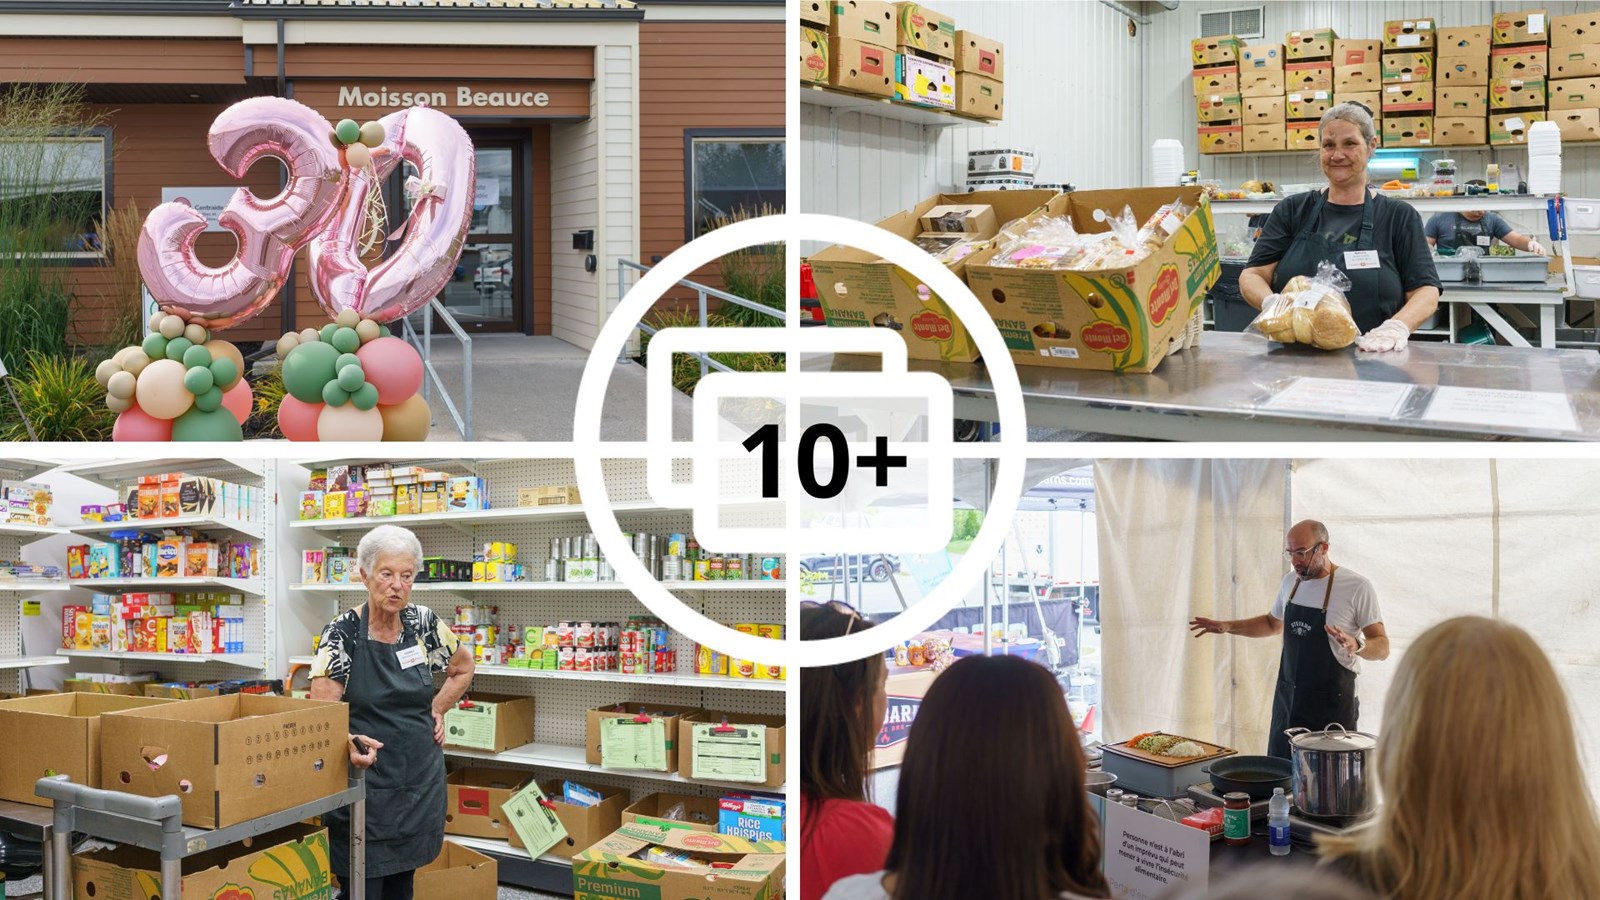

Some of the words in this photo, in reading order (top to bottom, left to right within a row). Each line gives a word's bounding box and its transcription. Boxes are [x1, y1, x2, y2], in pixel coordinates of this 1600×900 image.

[338, 86, 447, 107] Moisson
[457, 86, 549, 107] Beauce
[1122, 830, 1148, 846] Personne
[1149, 841, 1163, 852] n'est
[1169, 847, 1185, 859] l'abri
[1122, 840, 1134, 850] d'un
[1135, 844, 1158, 860] imprévu
[1159, 855, 1169, 864] qui
[1170, 859, 1185, 869] peut
[1118, 849, 1136, 861] mener
[1141, 858, 1155, 869] vivre
[578, 877, 641, 898] Premium
